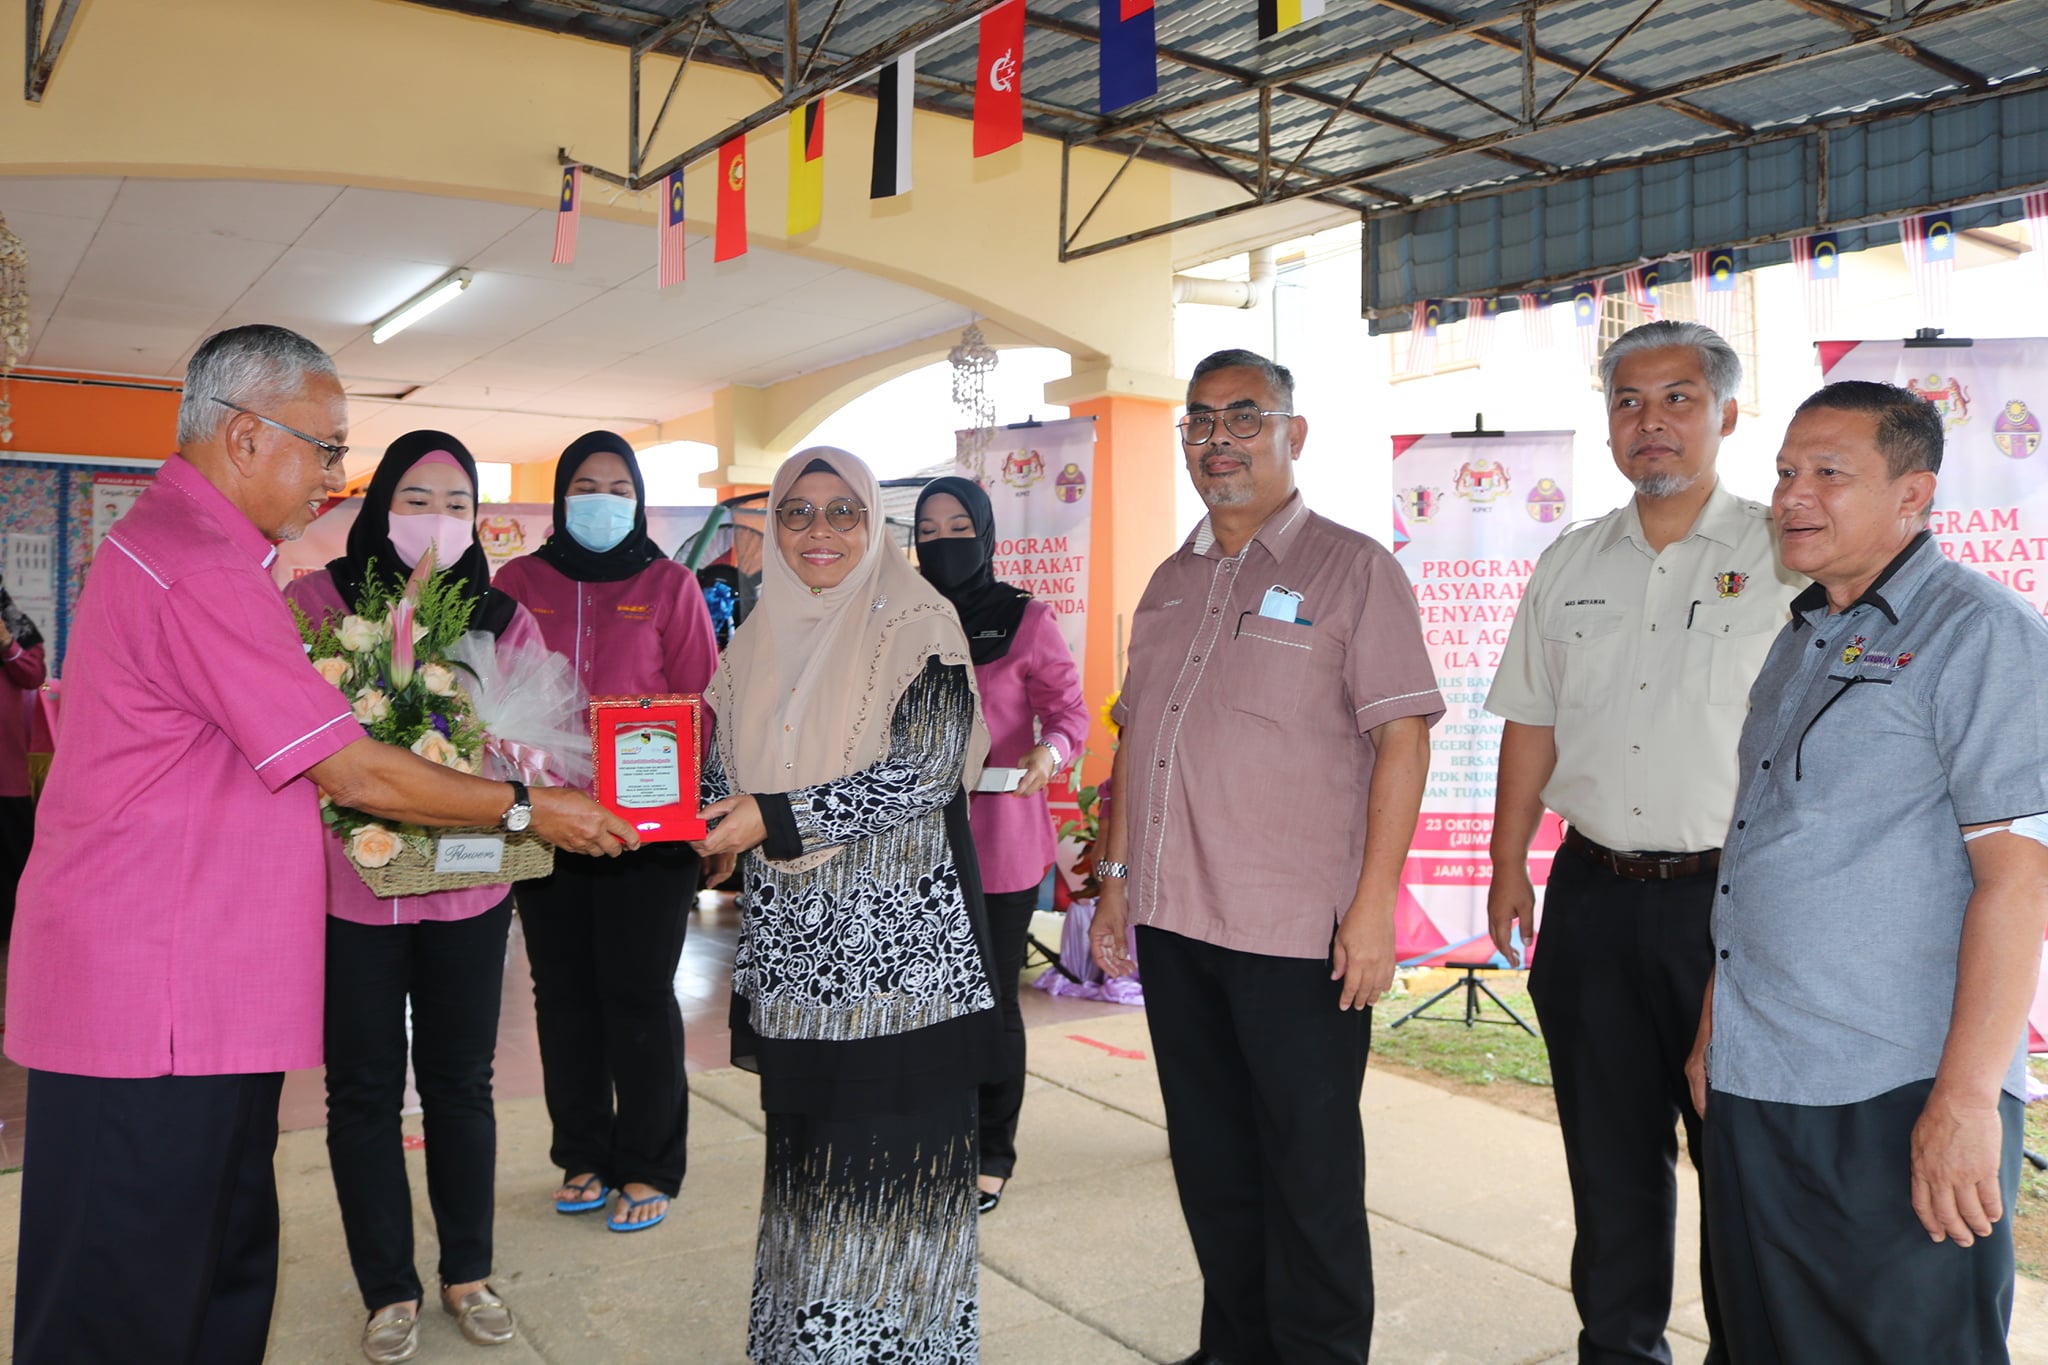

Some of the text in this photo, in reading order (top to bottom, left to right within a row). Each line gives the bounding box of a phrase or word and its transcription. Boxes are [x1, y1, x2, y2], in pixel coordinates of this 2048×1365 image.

[1926, 508, 2019, 535] GRAM
[1939, 537, 2048, 563] RAKAT
[992, 556, 1084, 576] SYARAKAT
[1044, 598, 1085, 614] NDA
[1426, 629, 1507, 646] CAL AG
[1488, 651, 1500, 667] 2
[1432, 740, 1472, 751] EGERI
[1450, 756, 1498, 767] BERSA
[1452, 787, 1497, 798] TUAN
[1425, 819, 1495, 831] 23 OKTOB
[445, 843, 495, 862] Flowers
[1433, 865, 1463, 877] JAM
